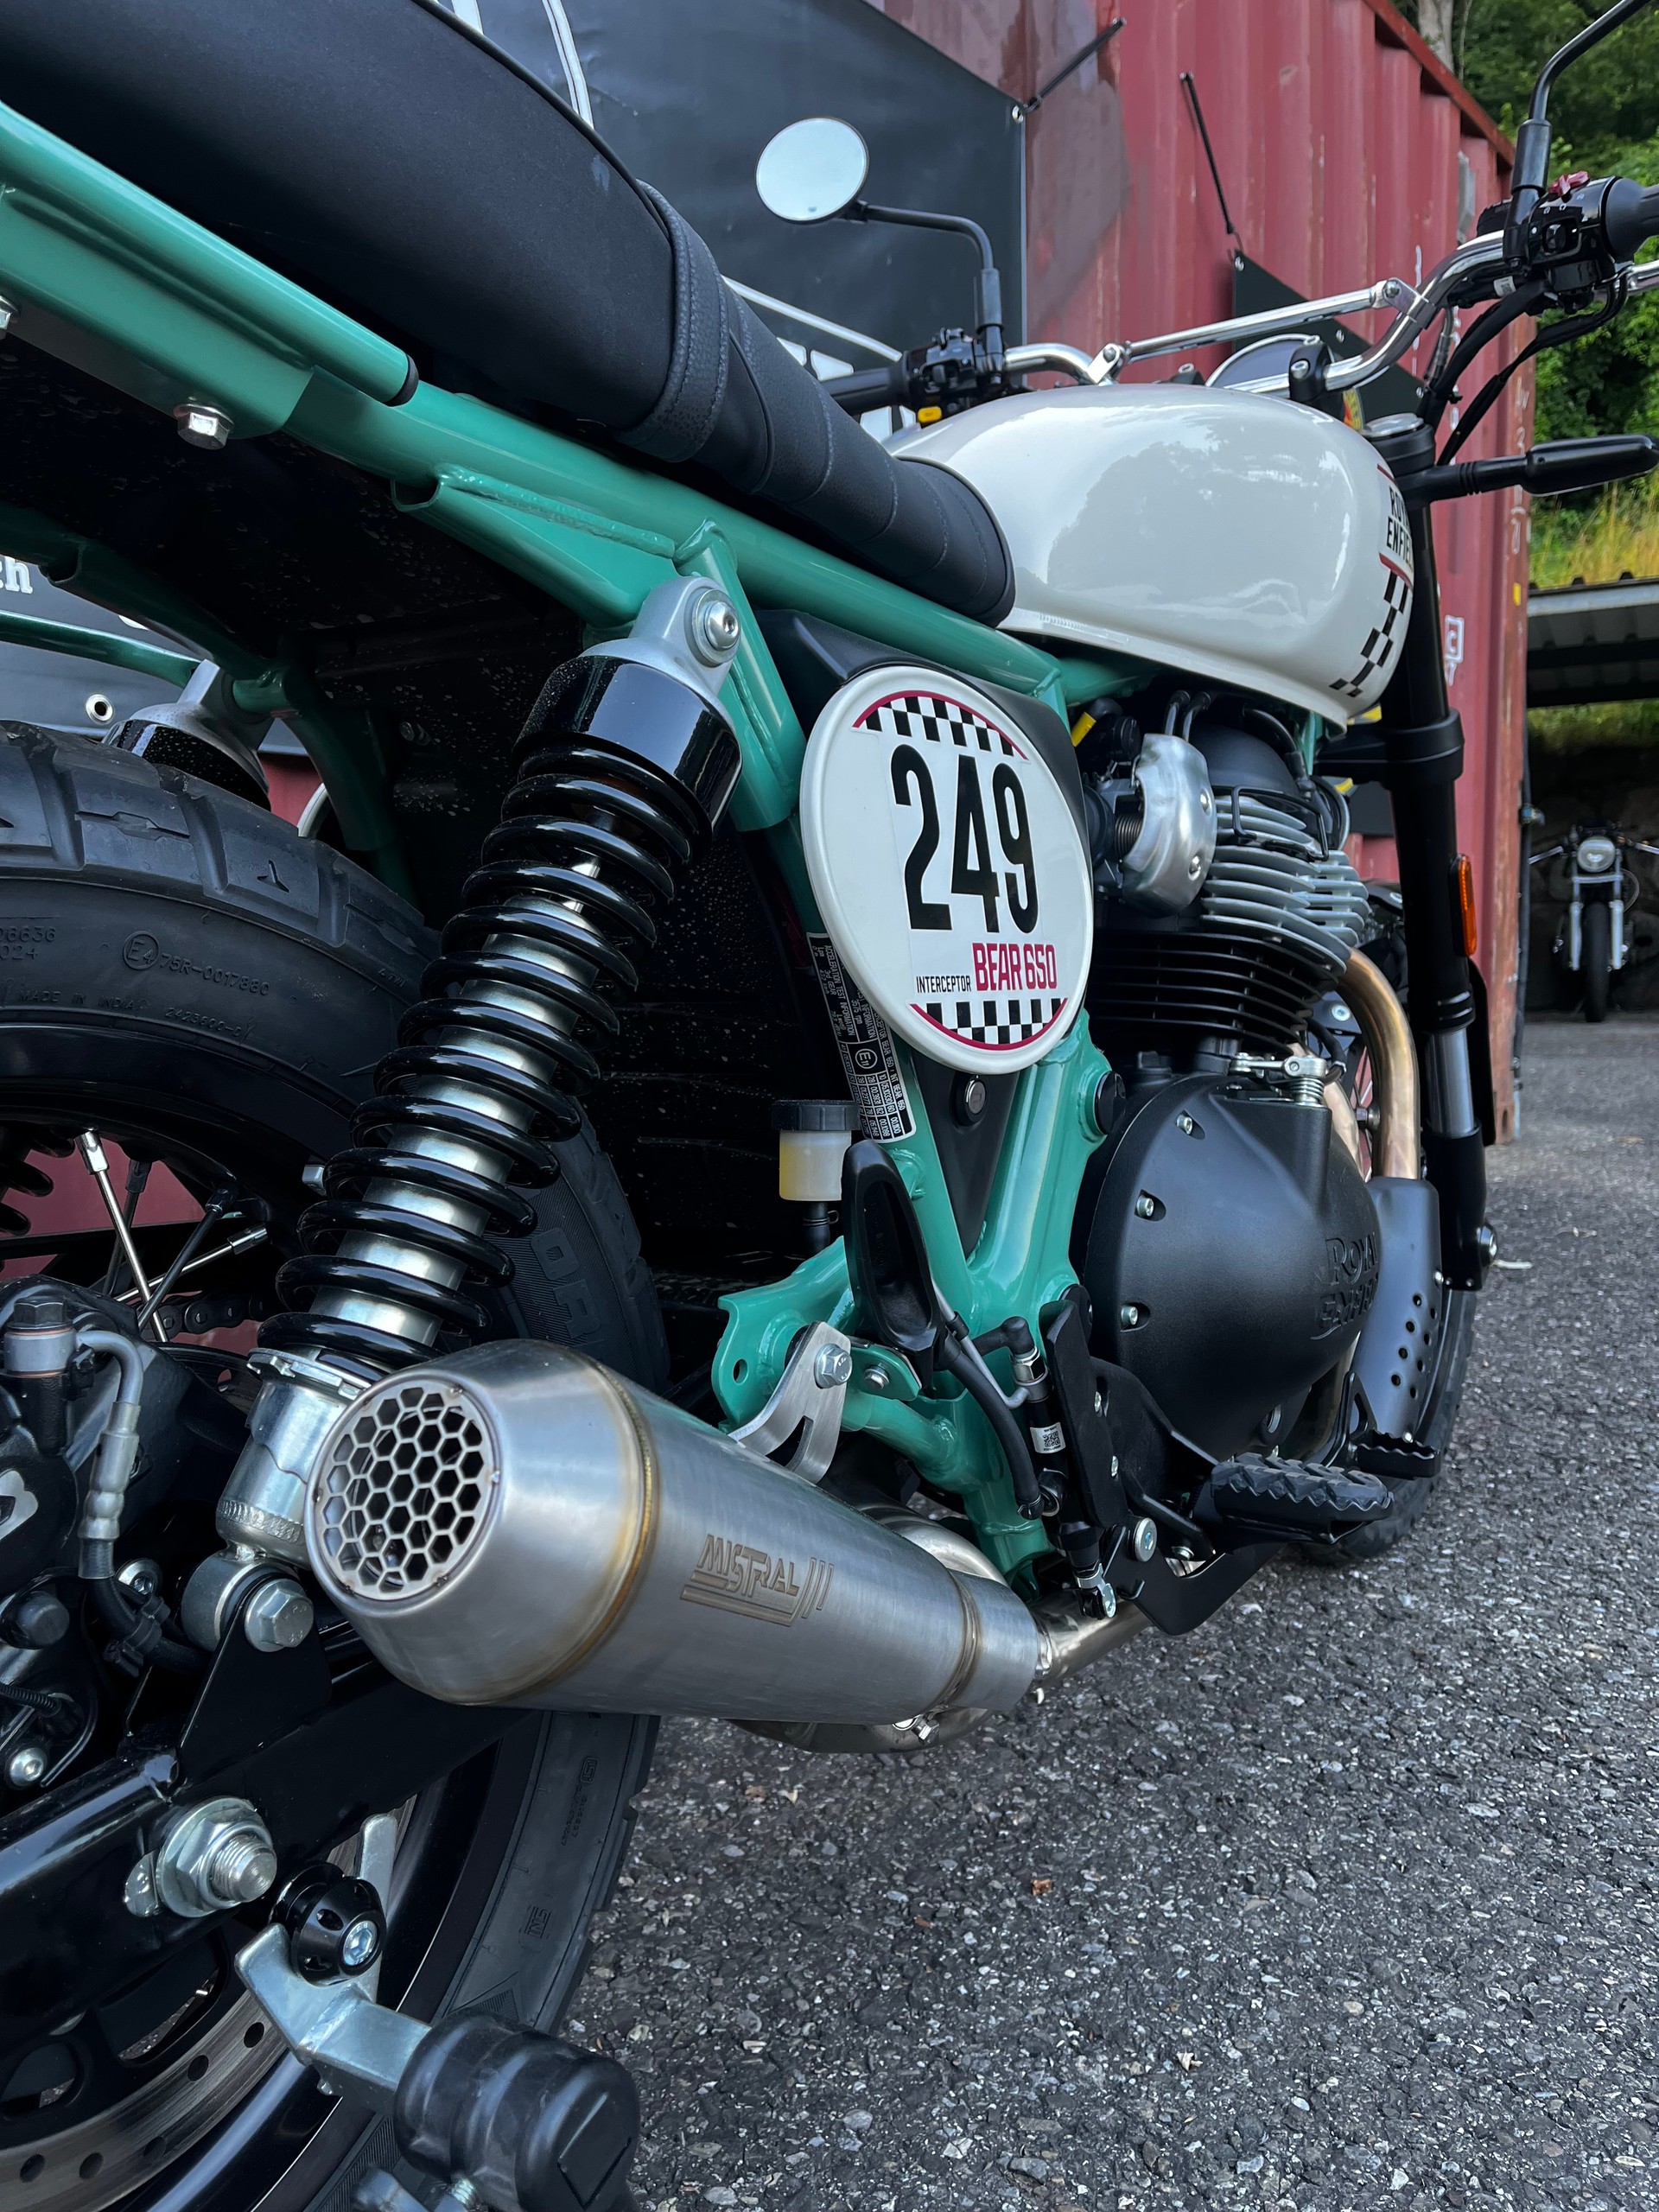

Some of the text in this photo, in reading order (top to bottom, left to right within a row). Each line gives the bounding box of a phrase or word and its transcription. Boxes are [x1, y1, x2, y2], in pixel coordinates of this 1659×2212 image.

[0, 556, 33, 594] h
[891, 744, 1039, 934] 249
[916, 943, 1058, 993] INTERCEPTOR BEAR 650
[18, 989, 61, 1002] MADE
[824, 945, 855, 1036] ACCELERATION TEST INFORMATION
[861, 1003, 876, 1039] INFORMATION
[881, 1039, 891, 1055] BEAR
[886, 1056, 894, 1068] 650
[890, 1072, 899, 1083] INT
[893, 1084, 902, 1099] BEAR
[897, 1099, 906, 1111] 650
[694, 1534, 800, 1598] MISTRAL
